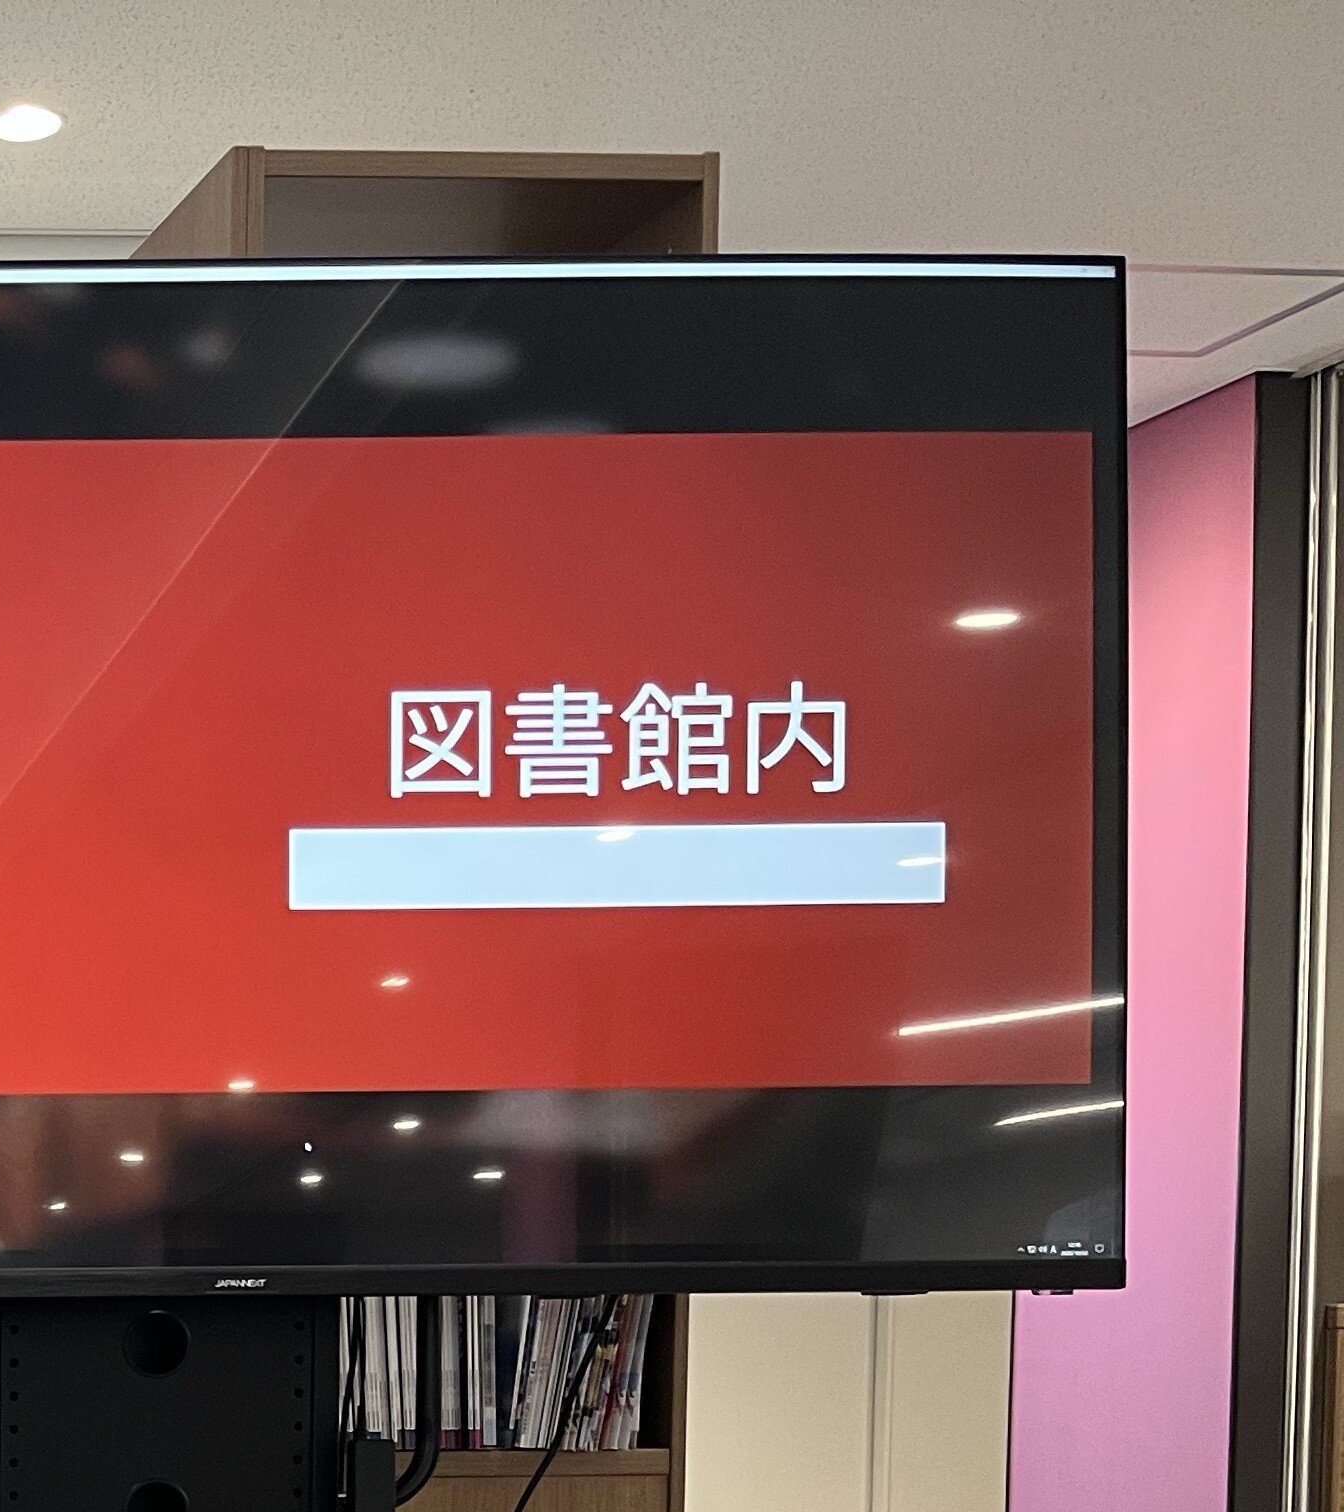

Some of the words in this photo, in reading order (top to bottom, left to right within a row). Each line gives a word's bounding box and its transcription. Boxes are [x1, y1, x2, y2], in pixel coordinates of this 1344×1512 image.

[390, 680, 847, 798] 図書館内
[214, 1278, 267, 1288] JAPANNEXT
